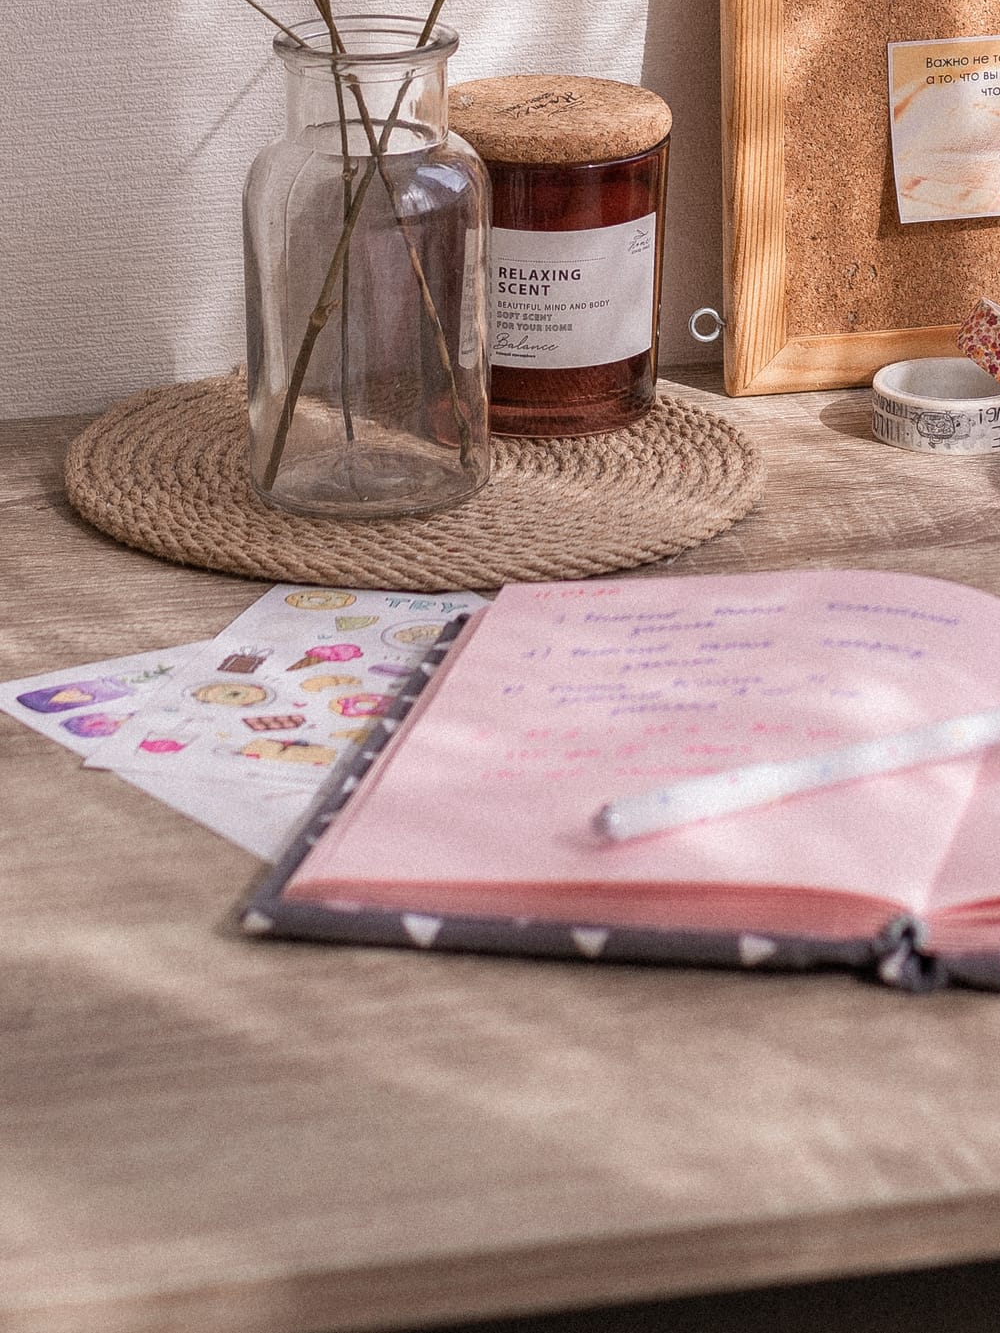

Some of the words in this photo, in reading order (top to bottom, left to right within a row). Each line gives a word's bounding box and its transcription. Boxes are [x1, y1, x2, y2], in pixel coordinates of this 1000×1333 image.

[926, 56, 969, 68] Важно
[973, 55, 989, 65] не
[926, 75, 935, 85] а
[939, 73, 957, 85] то,
[960, 71, 980, 83] что
[983, 69, 998, 80] вы
[981, 86, 1000, 97] что
[498, 266, 582, 282] RELAXING
[498, 281, 551, 297] SCENT
[497, 300, 541, 311] BEAUTIFUL
[544, 303, 567, 311] MIND
[569, 302, 587, 310] AND
[589, 299, 611, 309] BODY
[496, 311, 521, 320] SOFT
[522, 312, 553, 322] SCENT
[496, 320, 515, 330] FOR
[516, 322, 543, 332] YOUR
[544, 323, 573, 332] HOME
[492, 332, 560, 351] Balance
